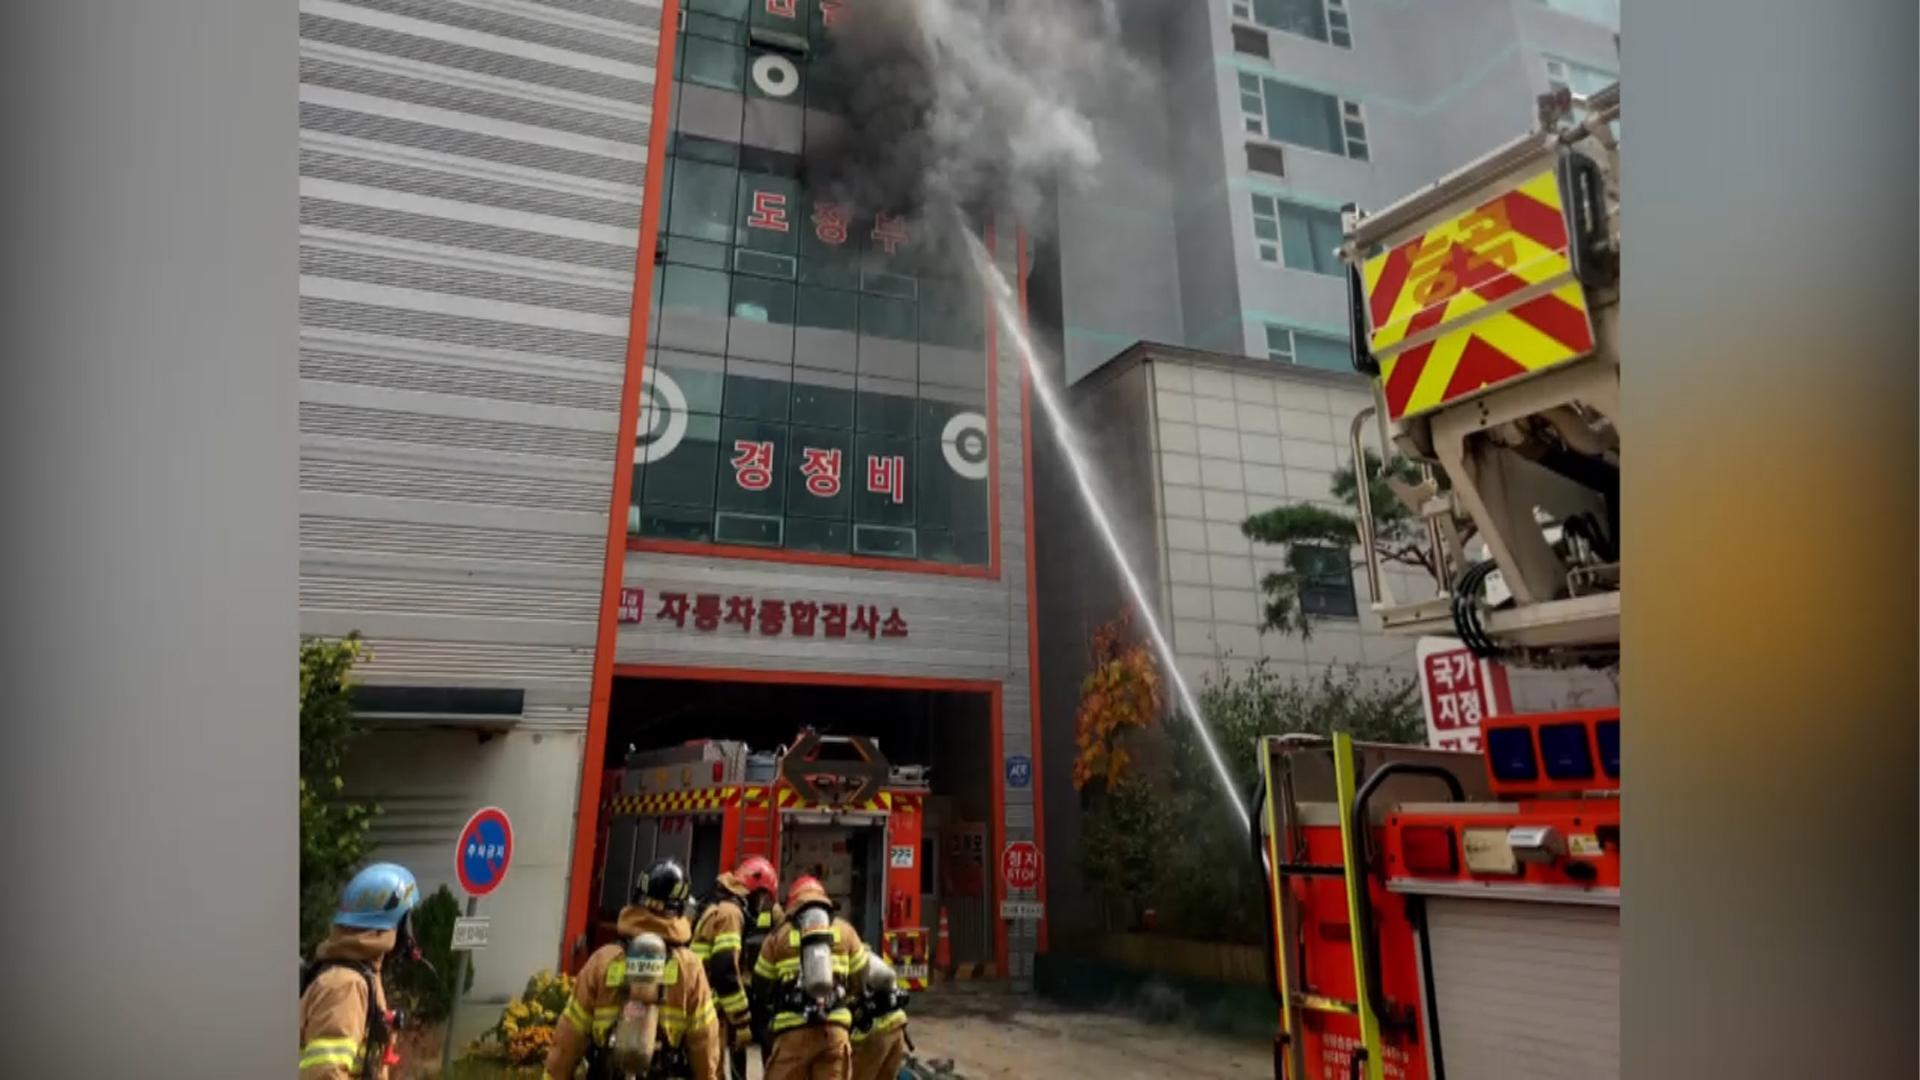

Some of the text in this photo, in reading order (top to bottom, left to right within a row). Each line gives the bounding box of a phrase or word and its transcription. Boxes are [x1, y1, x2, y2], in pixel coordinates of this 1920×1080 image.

[731, 439, 904, 504] 경정비
[656, 591, 908, 640] 자동차종합검사소
[1433, 652, 1475, 689] 국가
[1437, 689, 1481, 726] 지정
[1007, 851, 1038, 867] 정지
[1007, 869, 1036, 881] STOP
